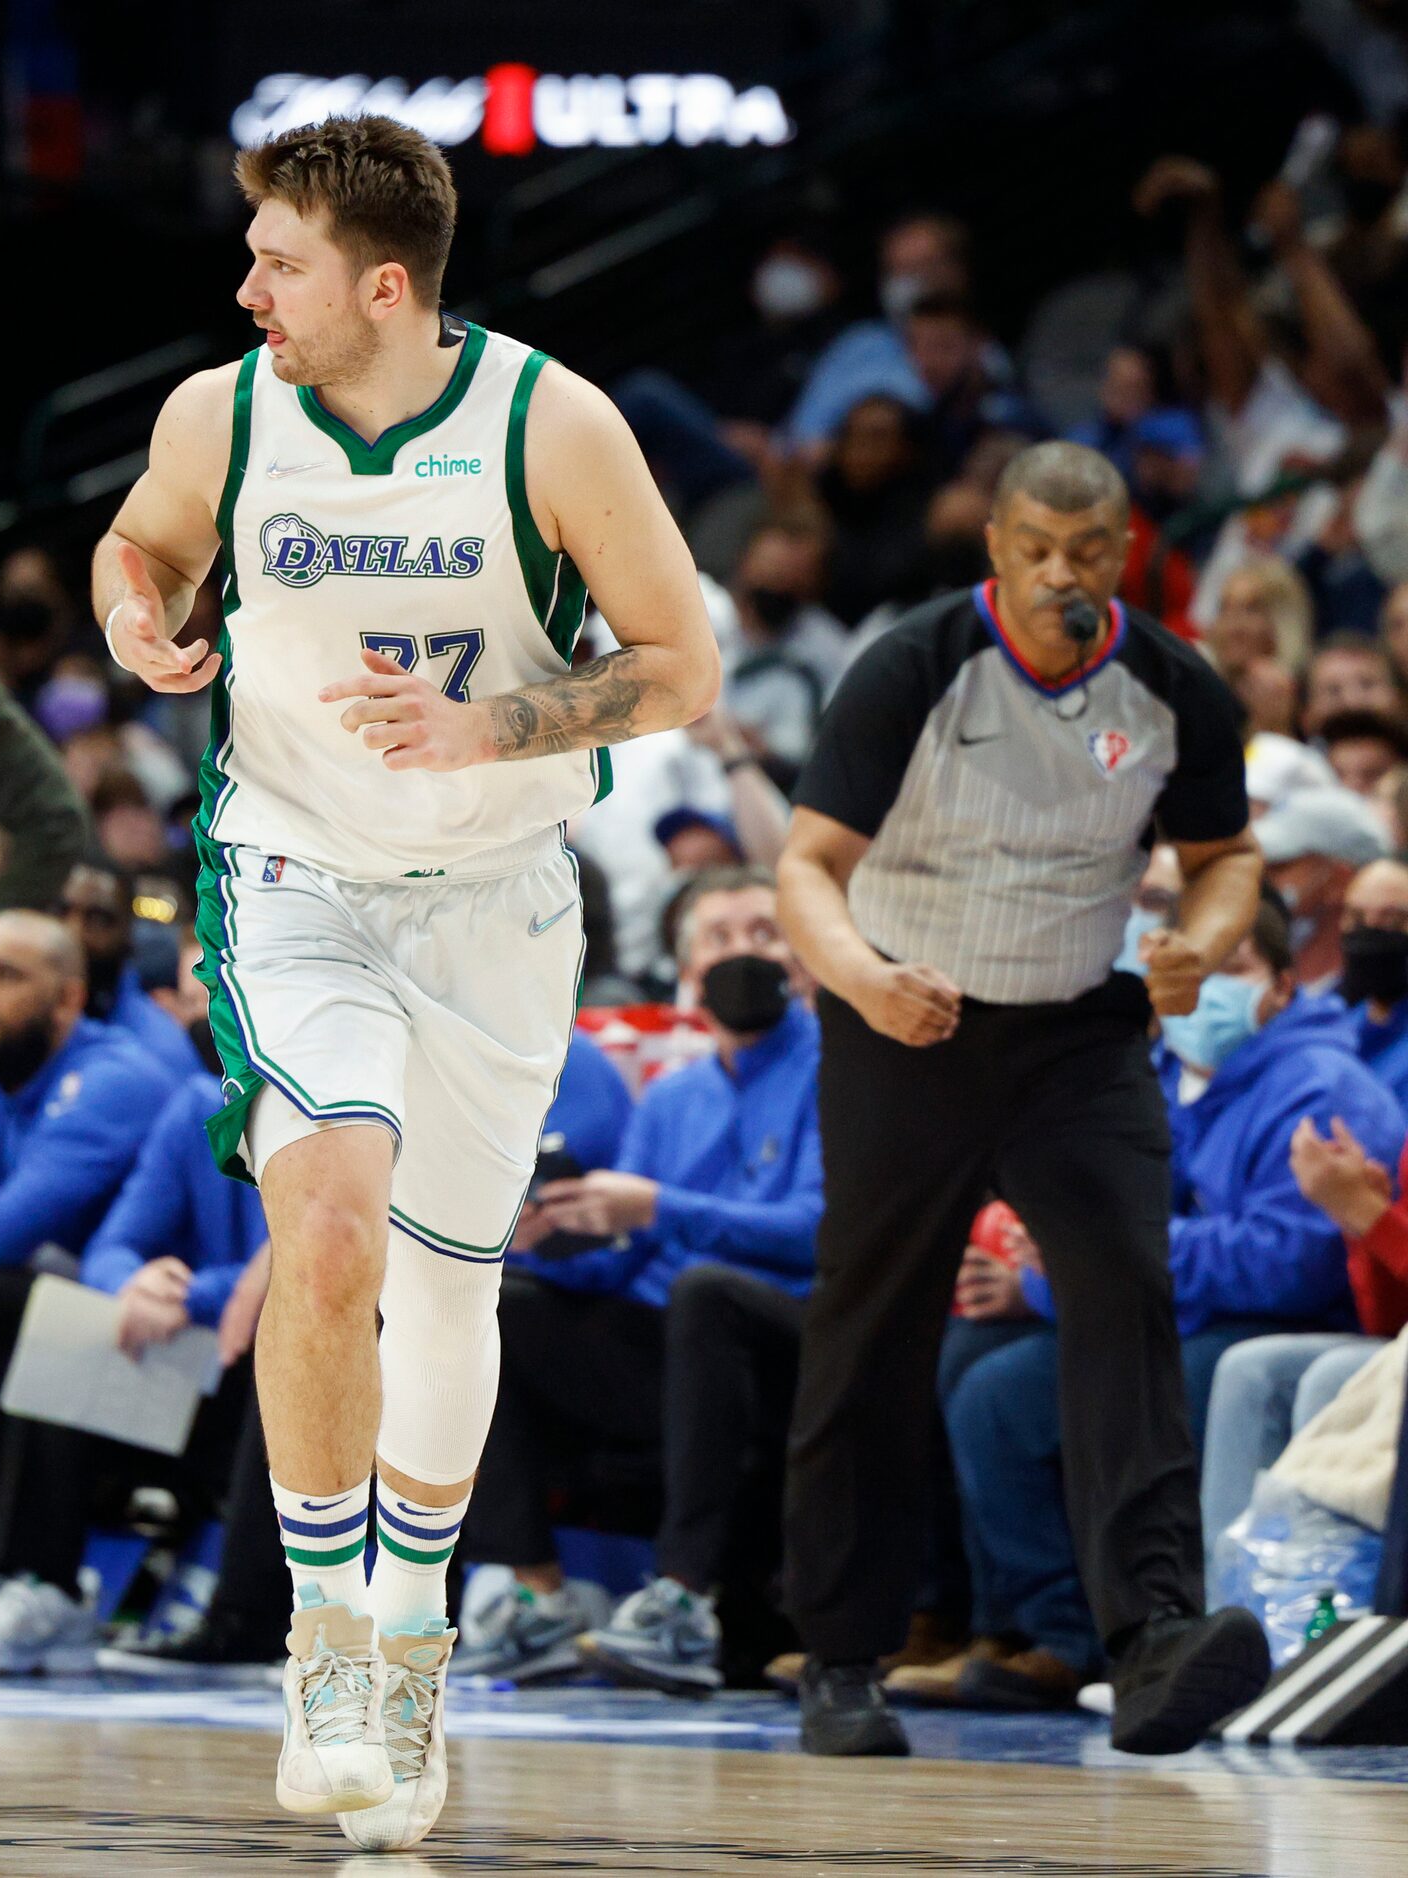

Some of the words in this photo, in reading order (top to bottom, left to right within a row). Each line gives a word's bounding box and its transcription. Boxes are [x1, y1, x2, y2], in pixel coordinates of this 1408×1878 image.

[533, 72, 795, 147] ULTRA
[415, 454, 482, 478] chime
[262, 534, 485, 579] DALLAS
